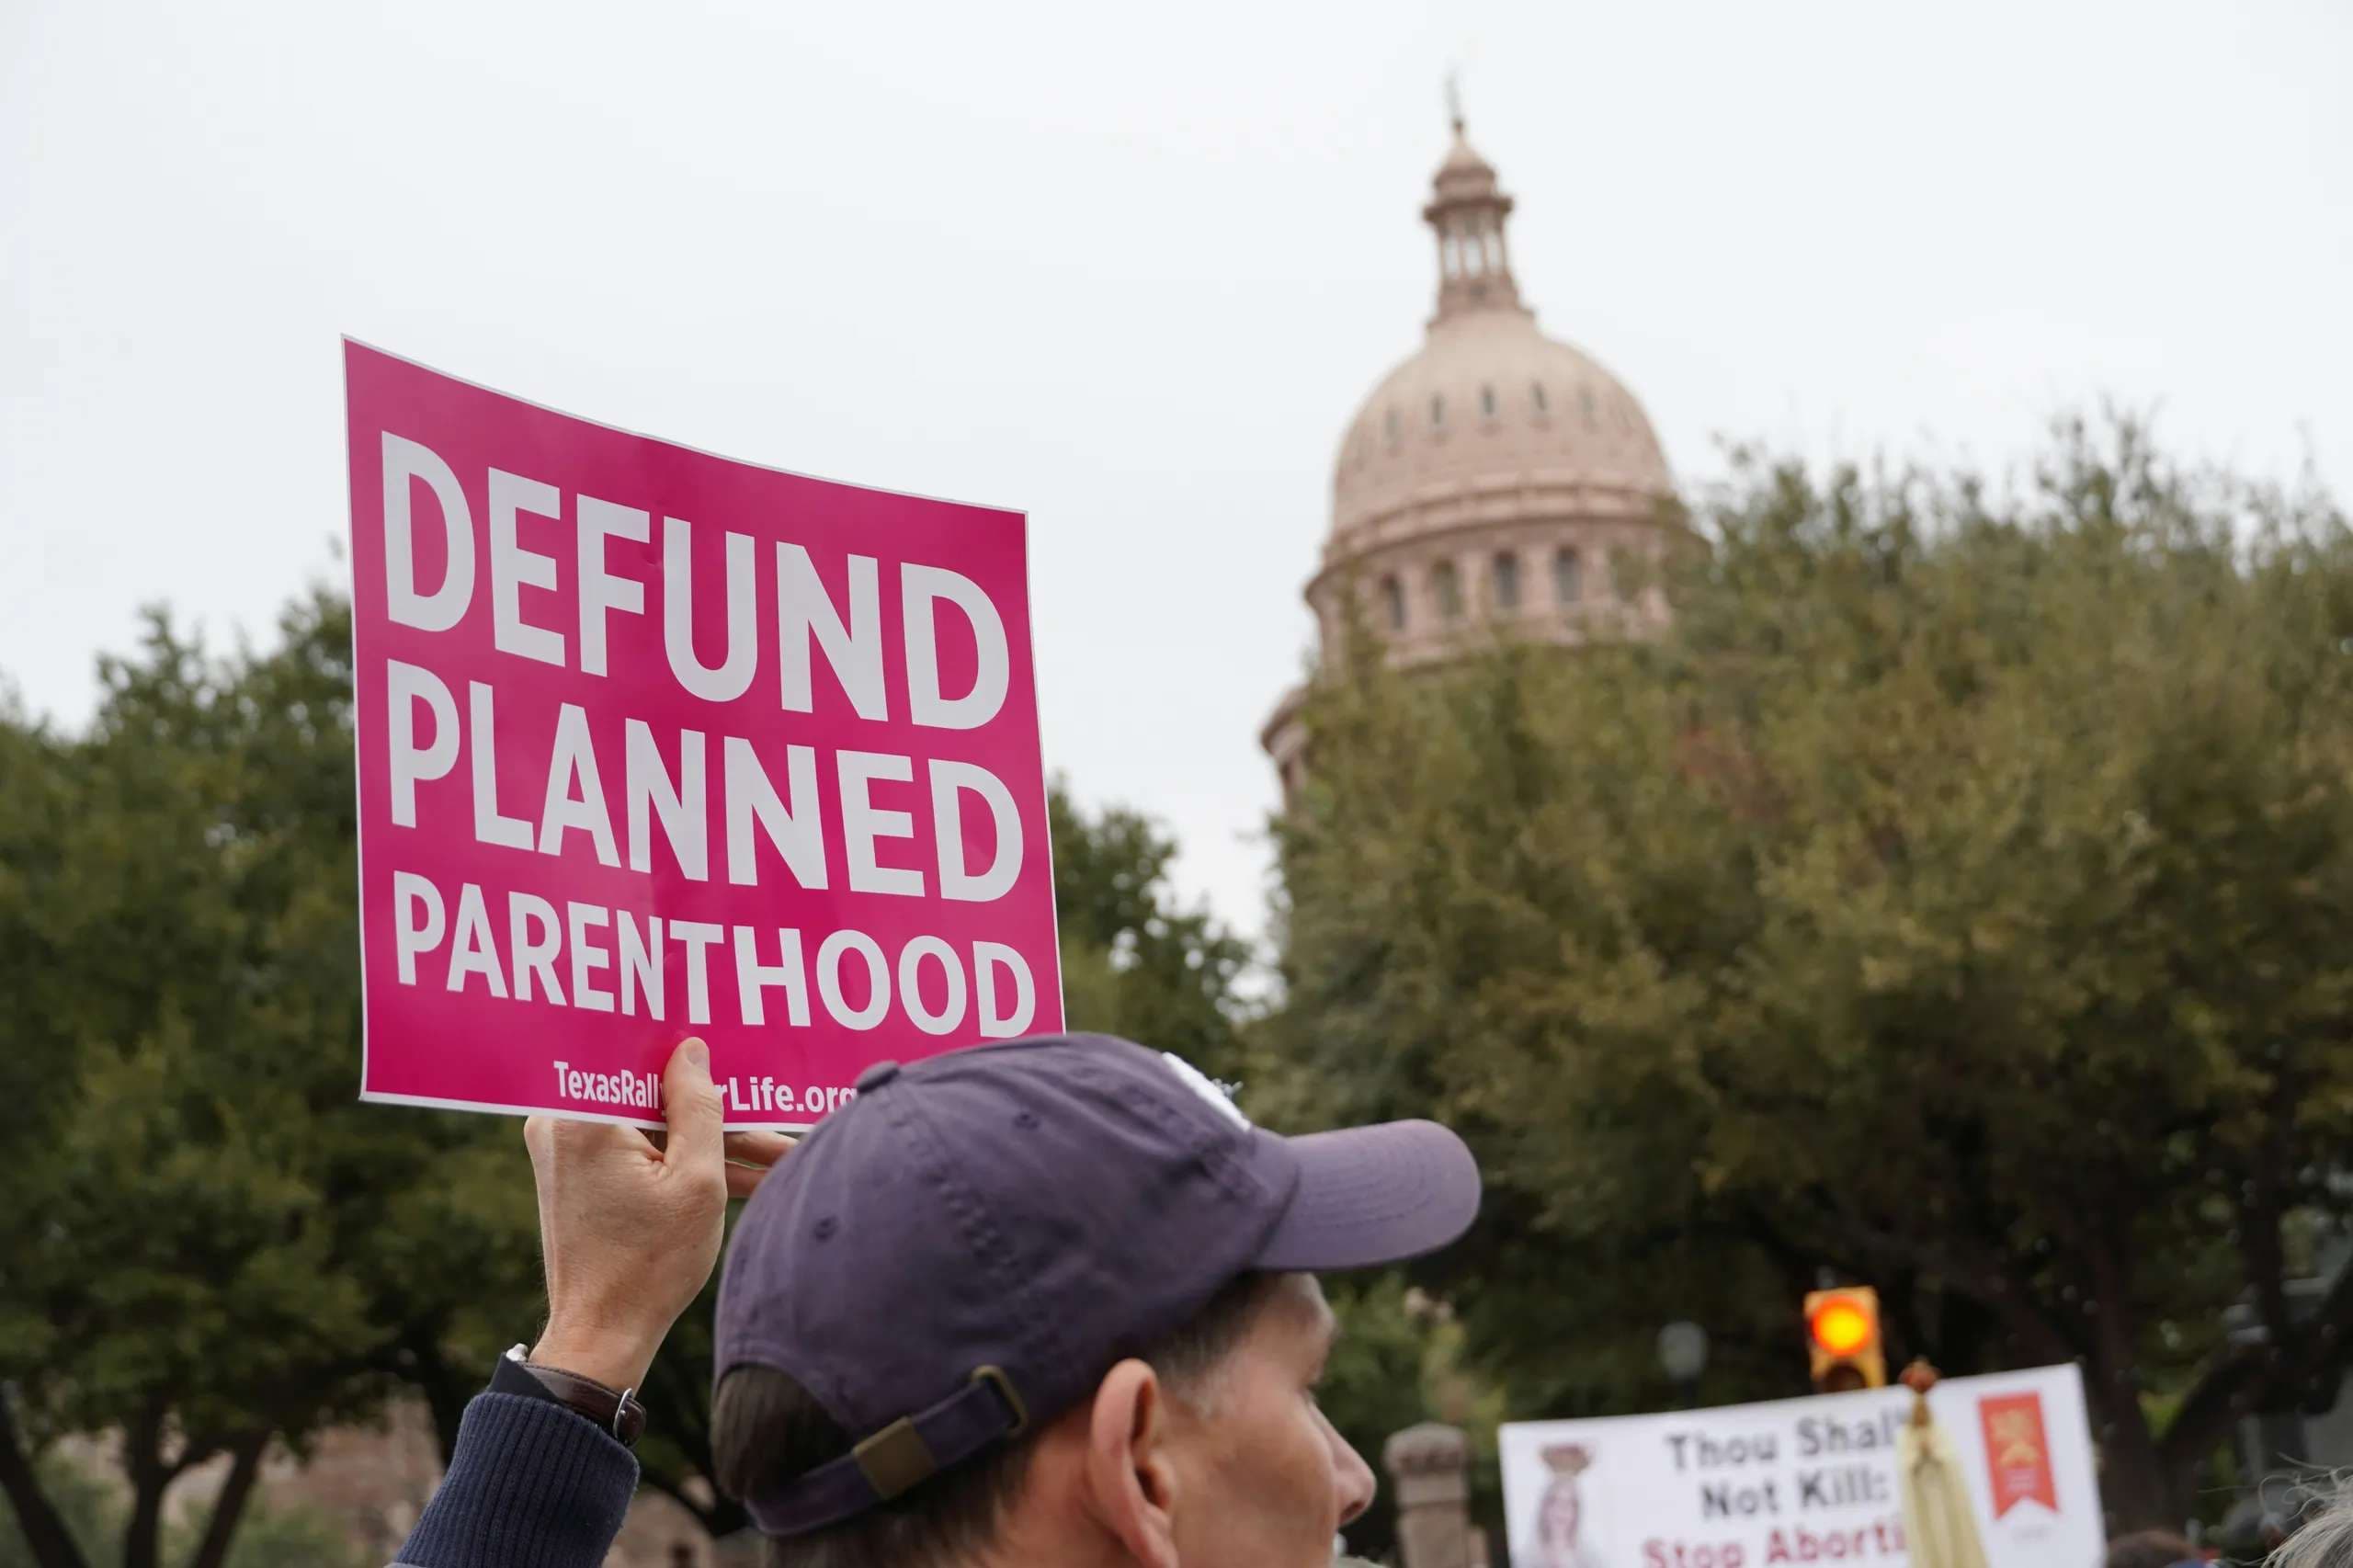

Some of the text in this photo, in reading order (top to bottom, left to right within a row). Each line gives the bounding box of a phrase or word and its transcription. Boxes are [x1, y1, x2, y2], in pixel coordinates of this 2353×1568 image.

[381, 430, 1009, 730] DEFUND
[387, 657, 1024, 903] PLANNED
[392, 869, 1036, 1039] PARENTHOOD
[1665, 1430, 1779, 1471] Thou
[1701, 1478, 1780, 1518] Not
[1767, 1516, 1908, 1564] Aborti
